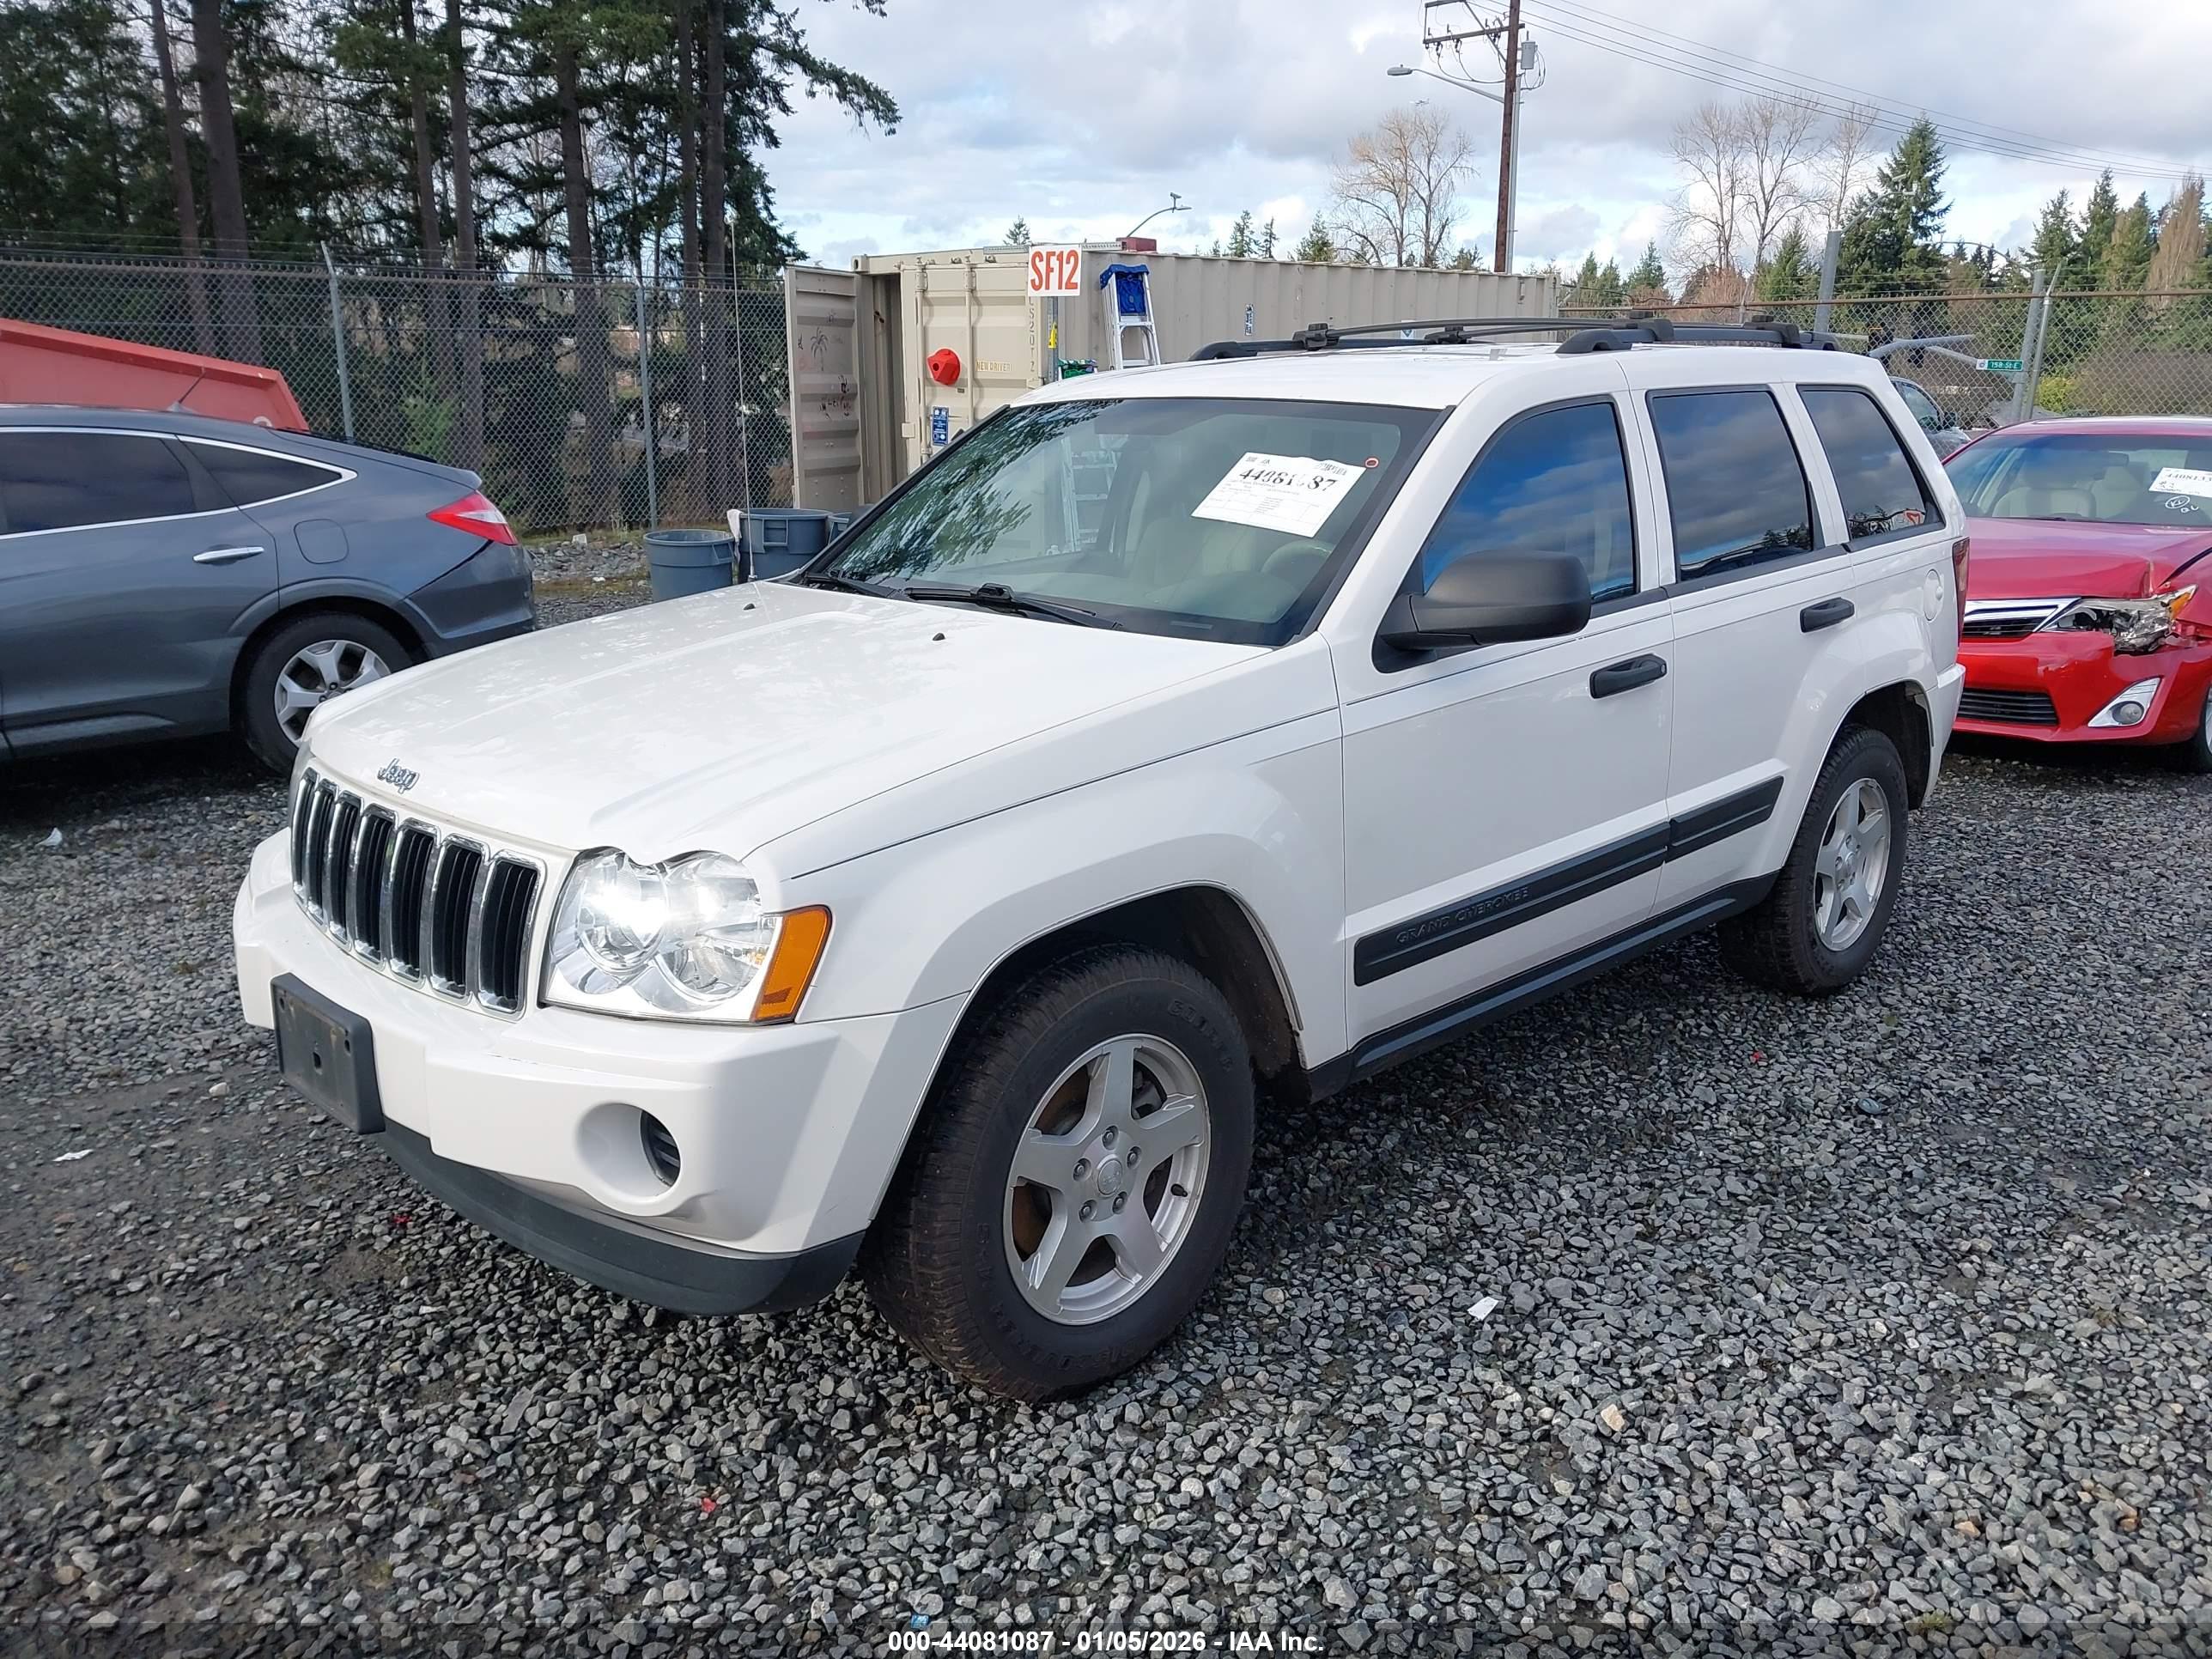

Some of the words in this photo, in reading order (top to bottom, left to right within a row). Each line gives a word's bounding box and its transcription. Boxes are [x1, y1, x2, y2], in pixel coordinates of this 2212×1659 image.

[1030, 249, 1079, 291] SF12
[377, 757, 420, 795] Jeep
[1396, 915, 1450, 944] GRAND
[1455, 887, 1529, 921] CHEROKEE
